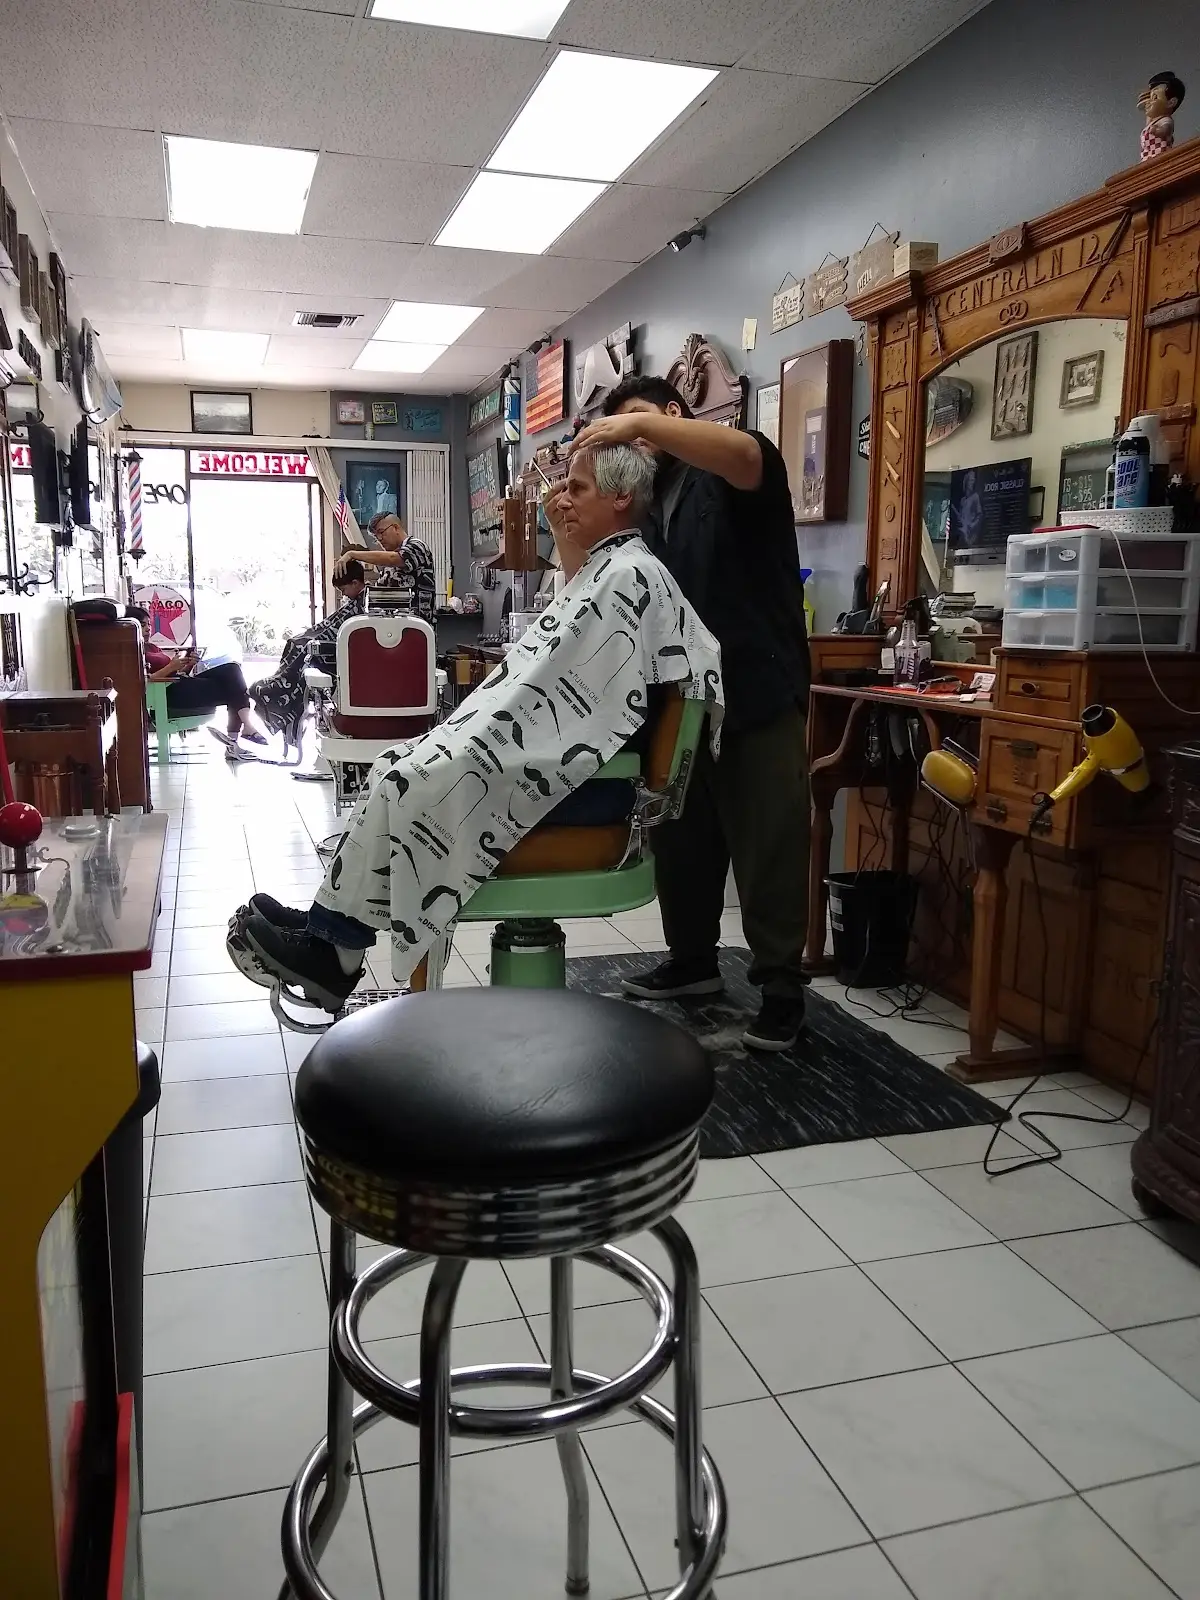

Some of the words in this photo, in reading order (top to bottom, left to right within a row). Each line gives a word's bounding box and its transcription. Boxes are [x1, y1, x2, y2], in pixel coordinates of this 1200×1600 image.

[615, 606, 640, 632] STUNTMAN
[651, 660, 660, 683] DISCO
[523, 709, 538, 726] VAMP
[467, 747, 494, 775] STUNTMAN
[560, 773, 576, 793] DISCO
[527, 789, 541, 803] CHIP
[422, 918, 441, 937] DISCO
[395, 940, 410, 954] CHIP
